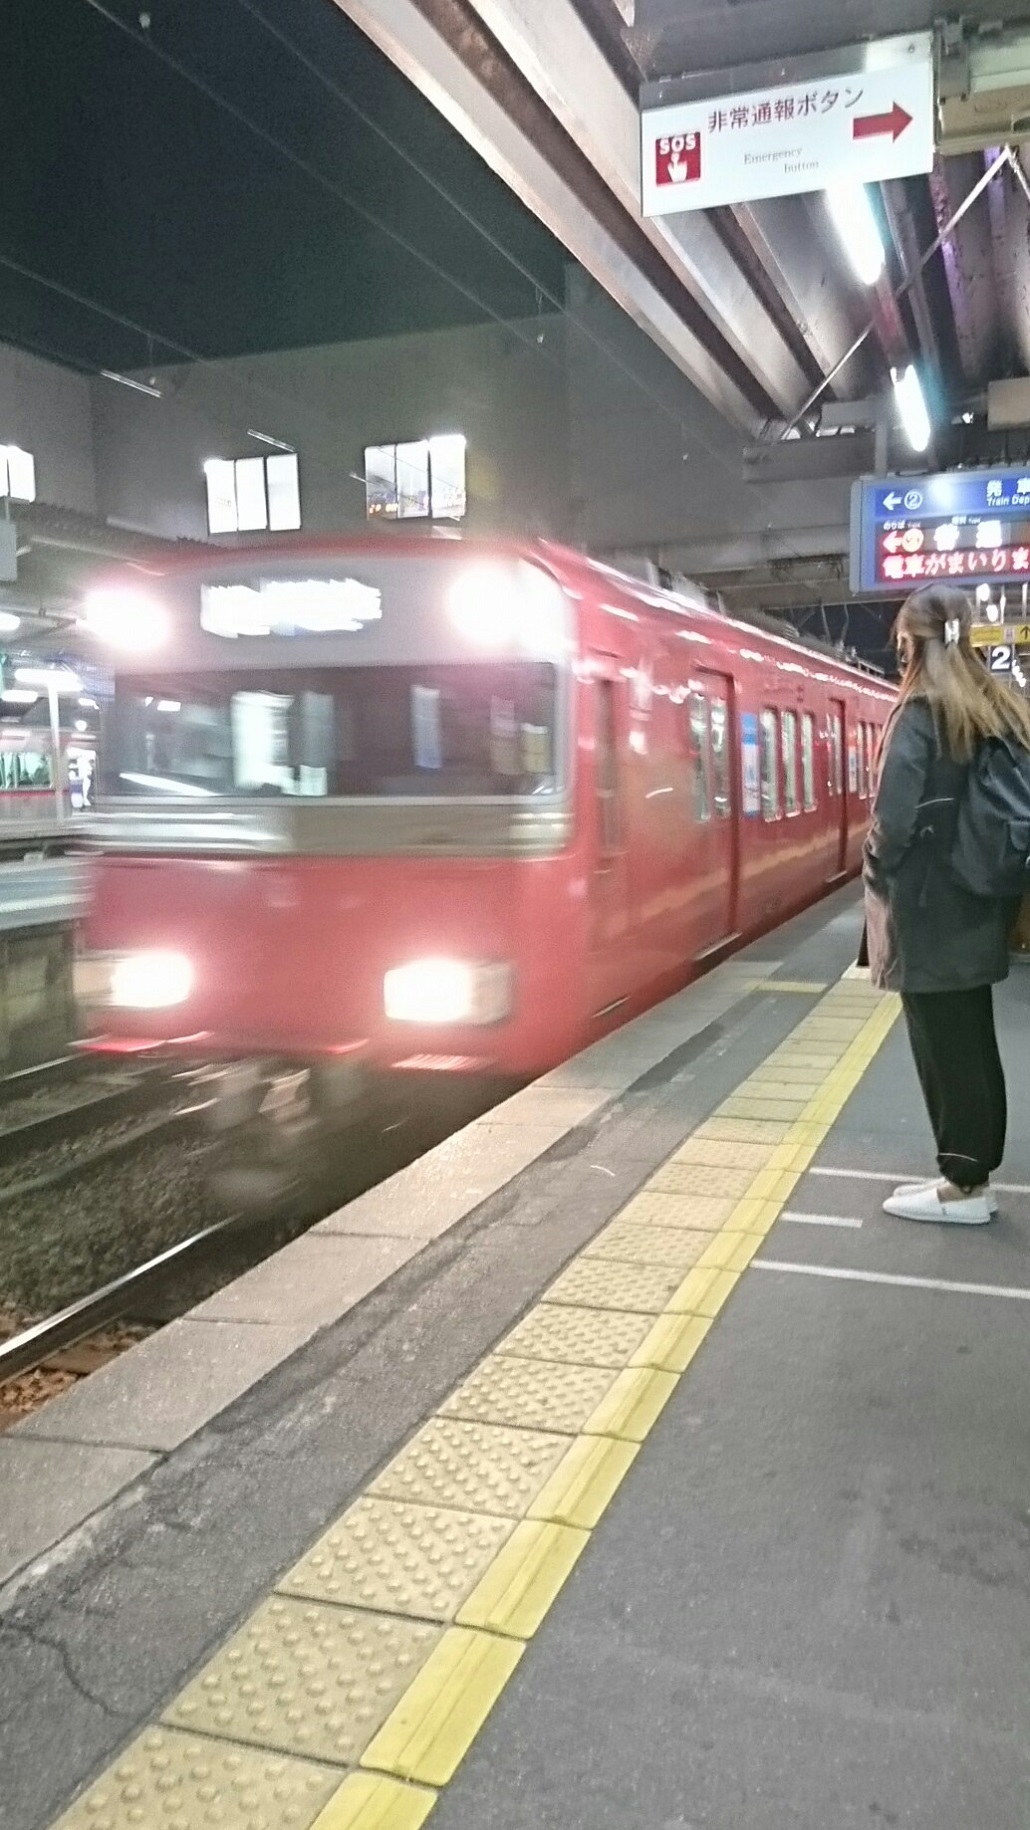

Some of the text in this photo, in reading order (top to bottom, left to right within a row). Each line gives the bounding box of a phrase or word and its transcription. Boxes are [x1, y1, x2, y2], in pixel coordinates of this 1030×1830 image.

[707, 88, 864, 133] 非常通報ボタン
[659, 134, 696, 155] SOS
[744, 148, 803, 165] Emergency
[784, 160, 819, 174] button
[987, 496, 1010, 507] Train
[991, 646, 1010, 670] 2
